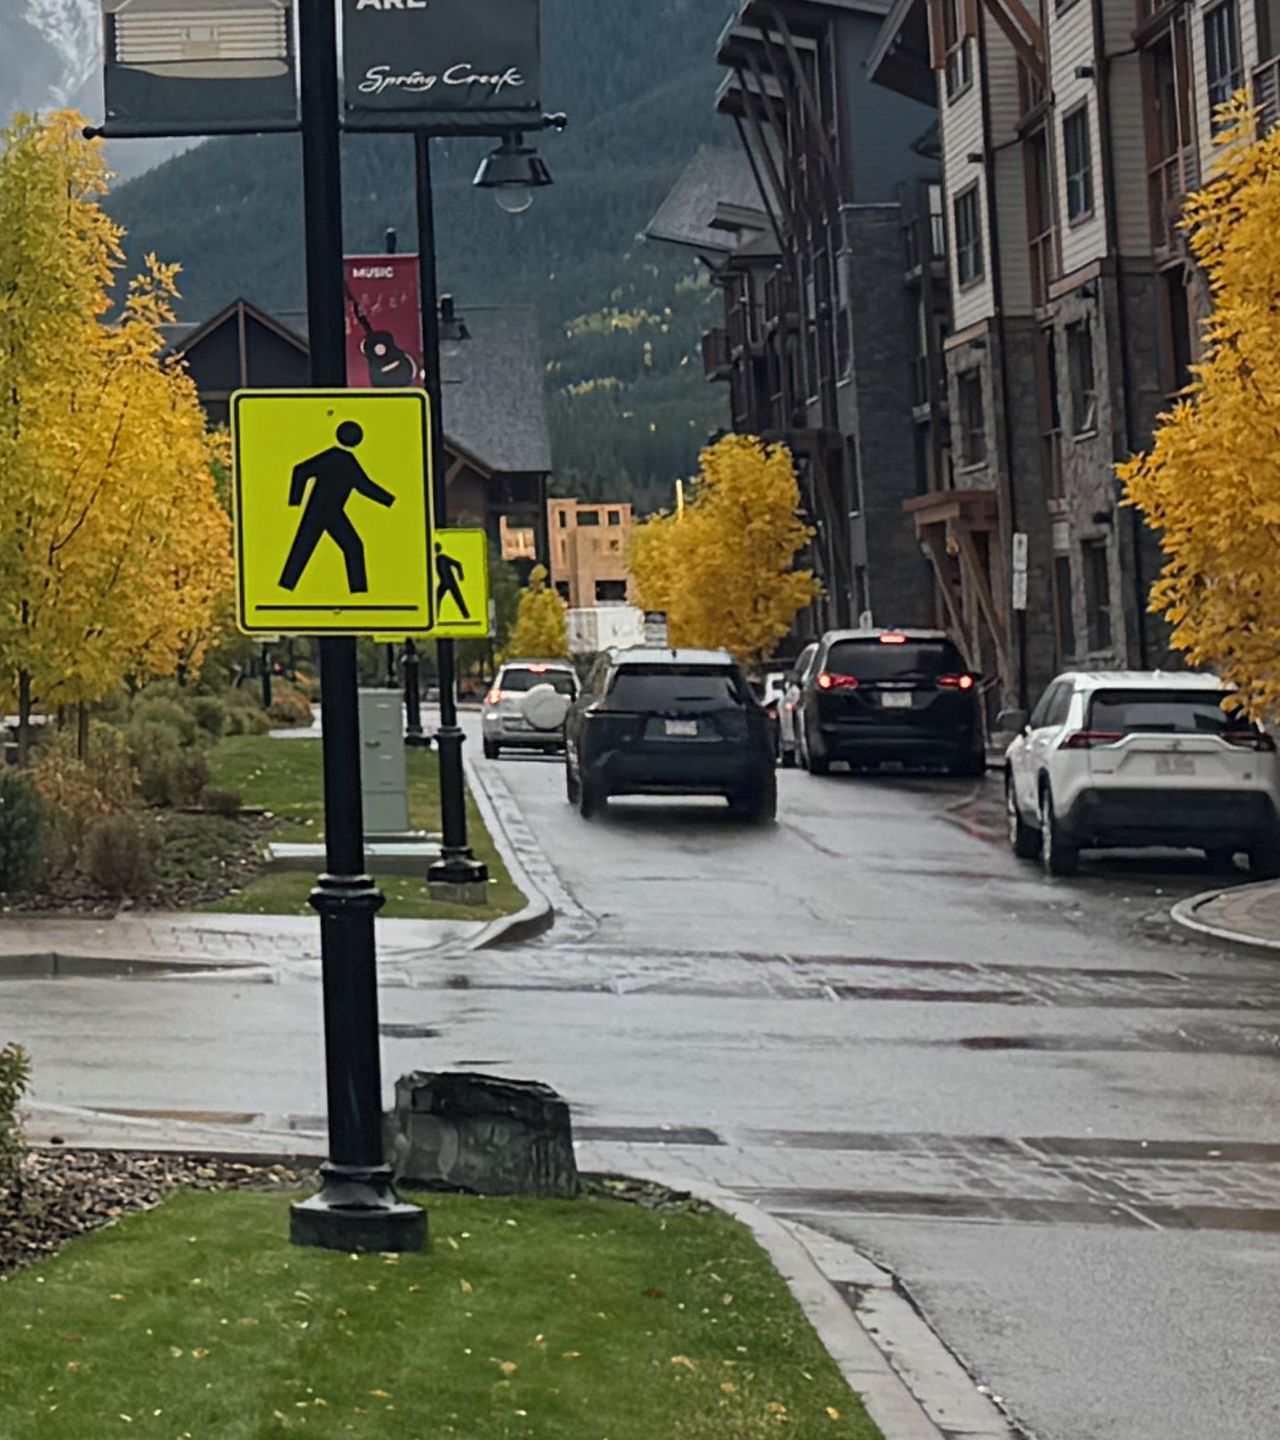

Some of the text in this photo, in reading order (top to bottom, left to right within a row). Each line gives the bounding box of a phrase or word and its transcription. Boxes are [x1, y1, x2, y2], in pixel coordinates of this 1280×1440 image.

[358, 63, 525, 94] Spring Creek
[352, 267, 393, 278] MUSIC
